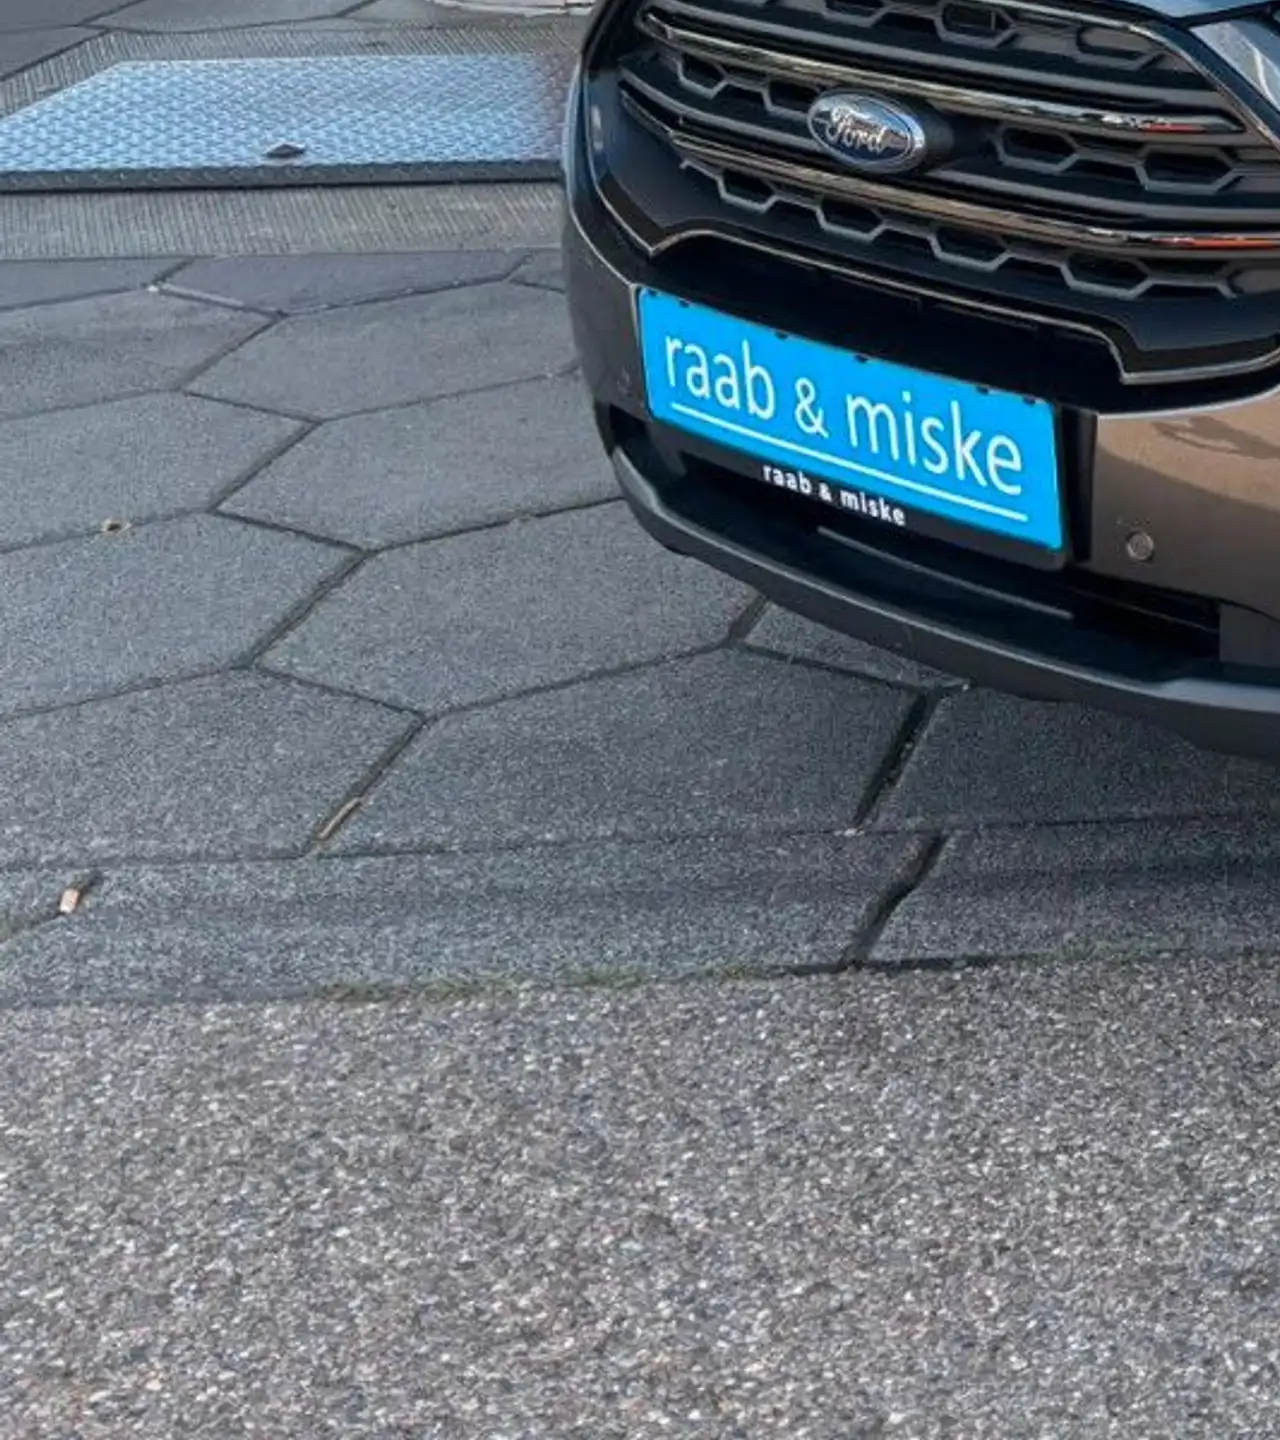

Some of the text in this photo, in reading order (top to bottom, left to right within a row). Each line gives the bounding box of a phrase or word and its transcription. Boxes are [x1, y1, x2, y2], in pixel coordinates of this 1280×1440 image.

[819, 105, 908, 154] Ford
[664, 333, 1022, 497] raab & miske
[762, 463, 907, 528] raab & miske
